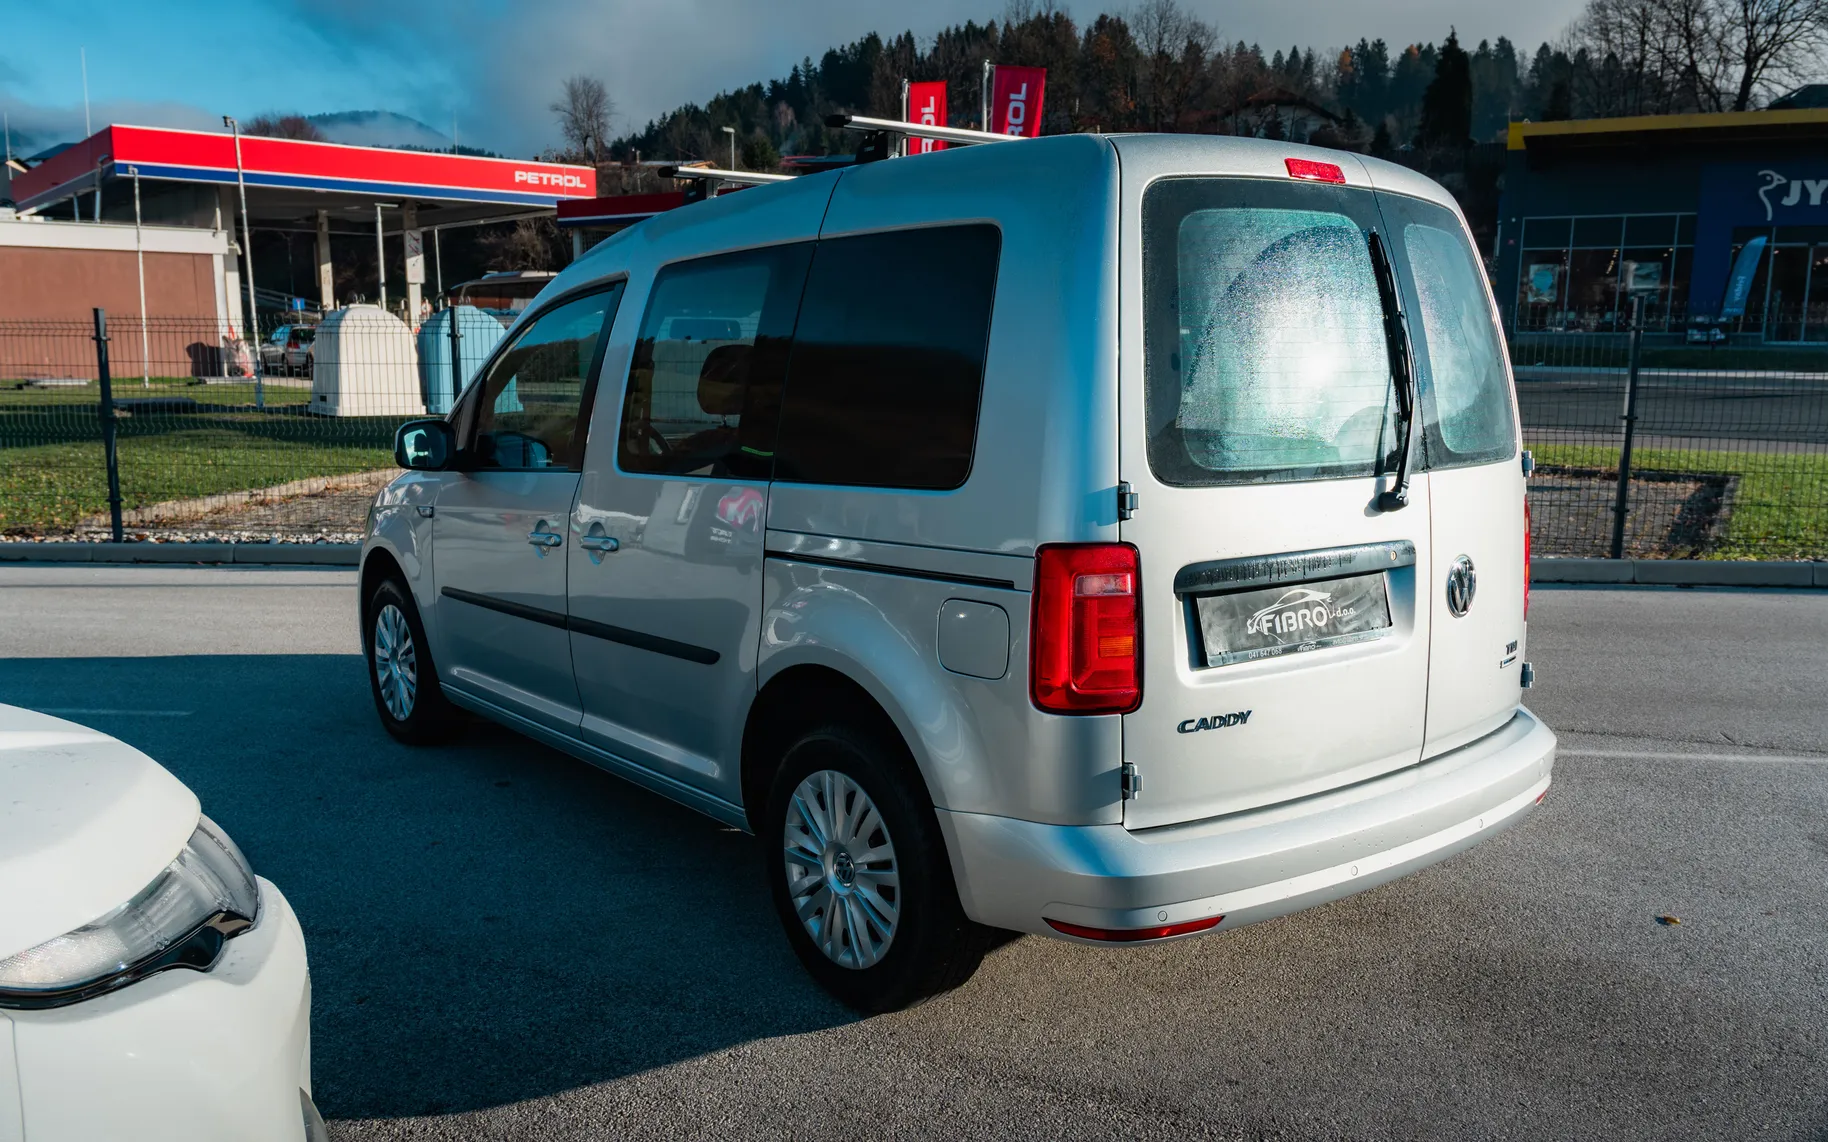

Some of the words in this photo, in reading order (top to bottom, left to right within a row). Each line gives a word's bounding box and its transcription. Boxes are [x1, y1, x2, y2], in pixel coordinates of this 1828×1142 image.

[514, 170, 587, 188] PETROL
[1781, 179, 1828, 206] JY
[1260, 606, 1328, 635] FIBRO
[1177, 709, 1252, 734] CADDY
